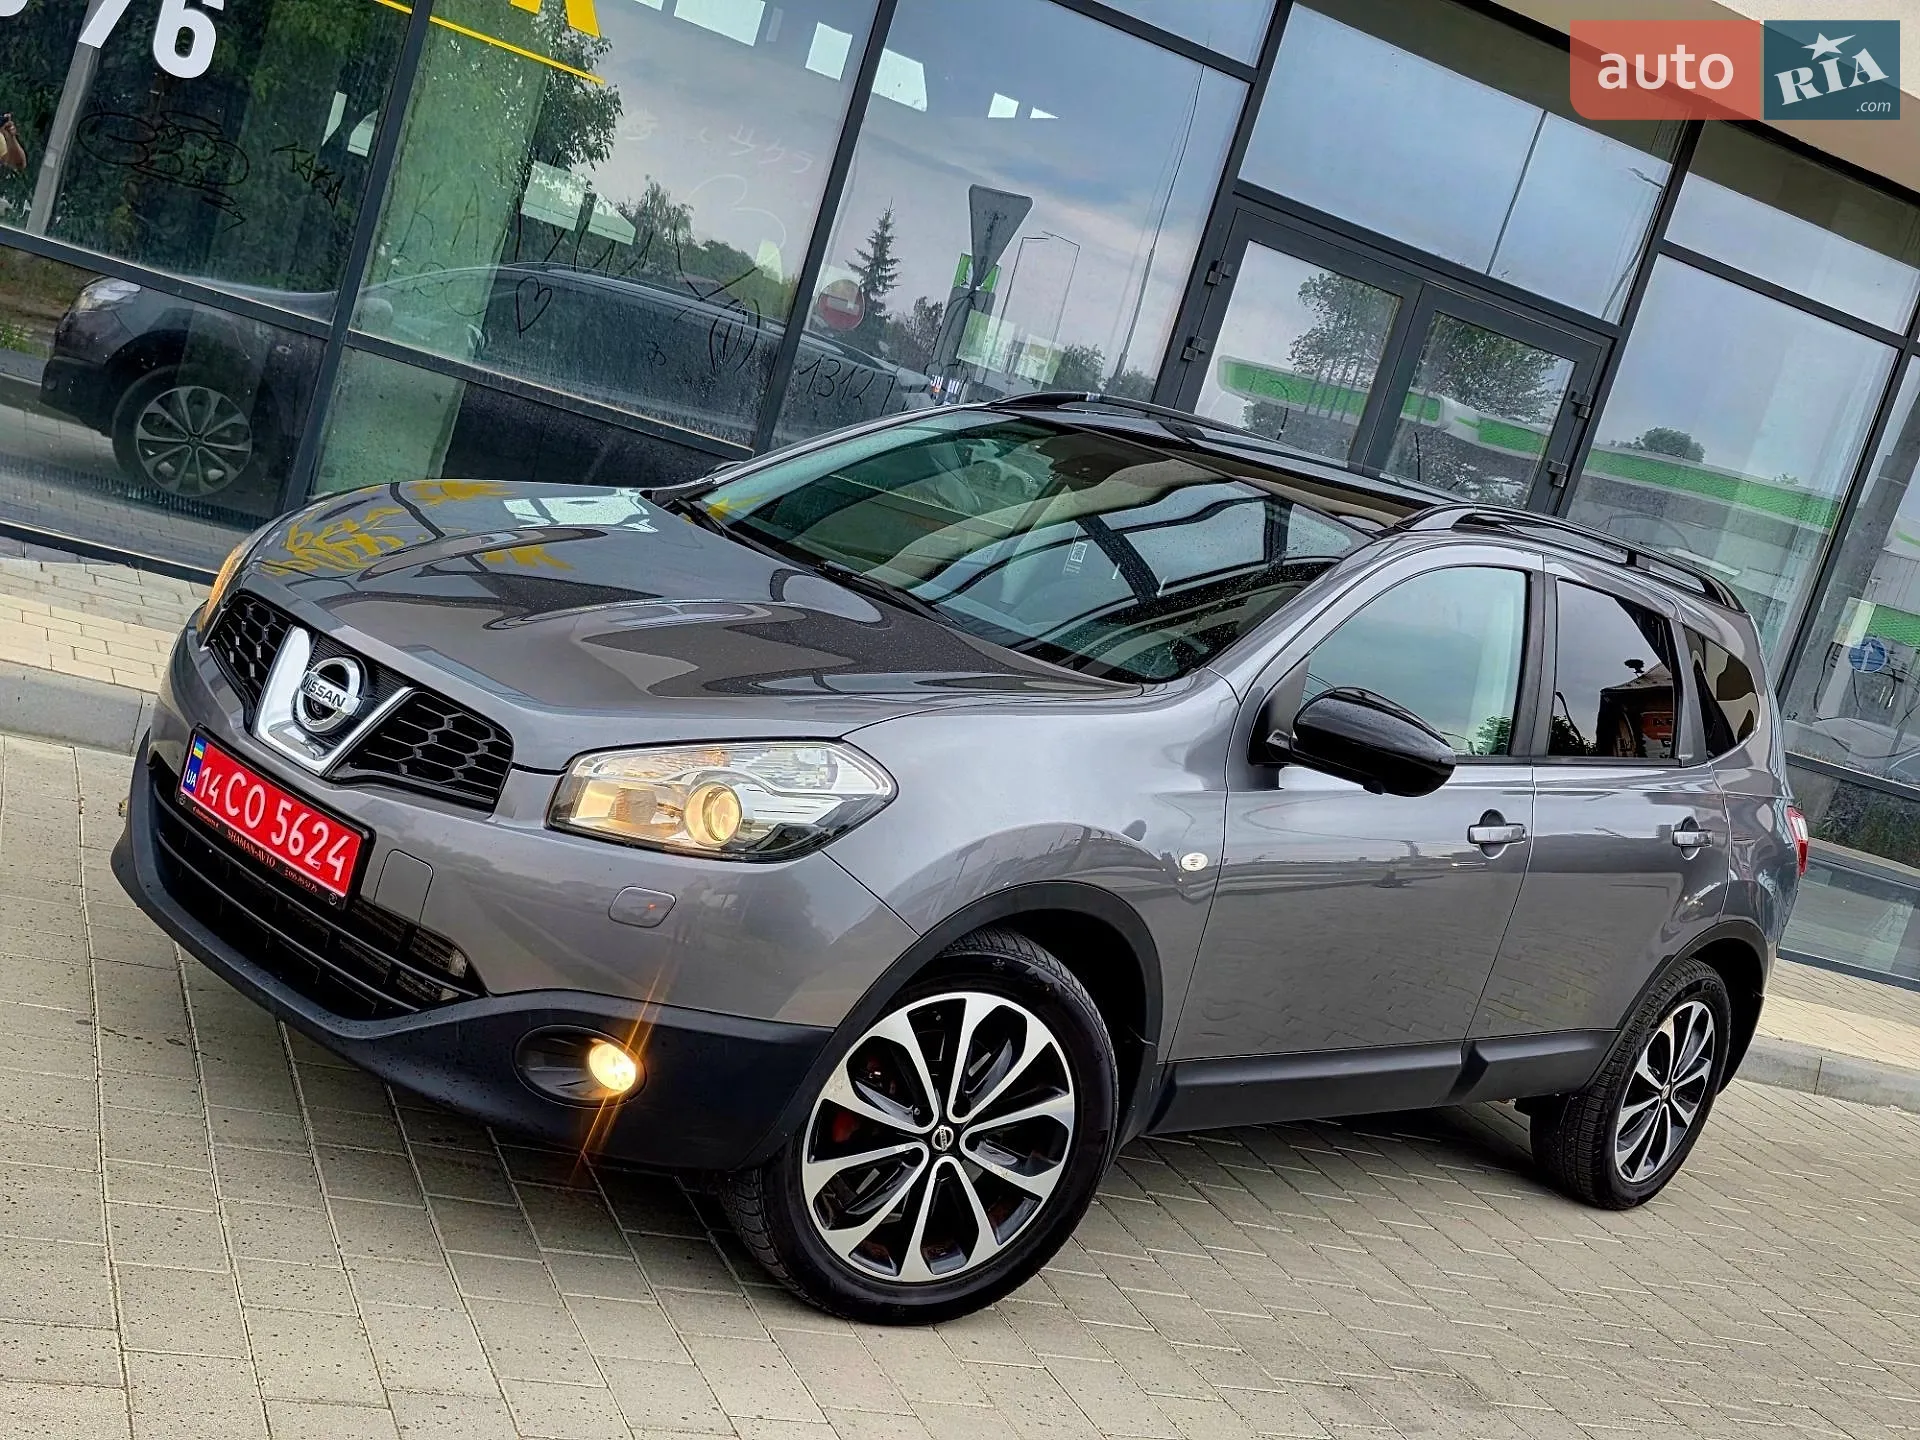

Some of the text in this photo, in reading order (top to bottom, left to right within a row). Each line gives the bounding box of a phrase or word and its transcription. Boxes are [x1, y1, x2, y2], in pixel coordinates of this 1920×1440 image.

[302, 675, 346, 708] NISSAN
[186, 769, 197, 788] UA
[201, 767, 223, 806] 14
[225, 772, 266, 829] CO
[270, 799, 351, 882] 5624
